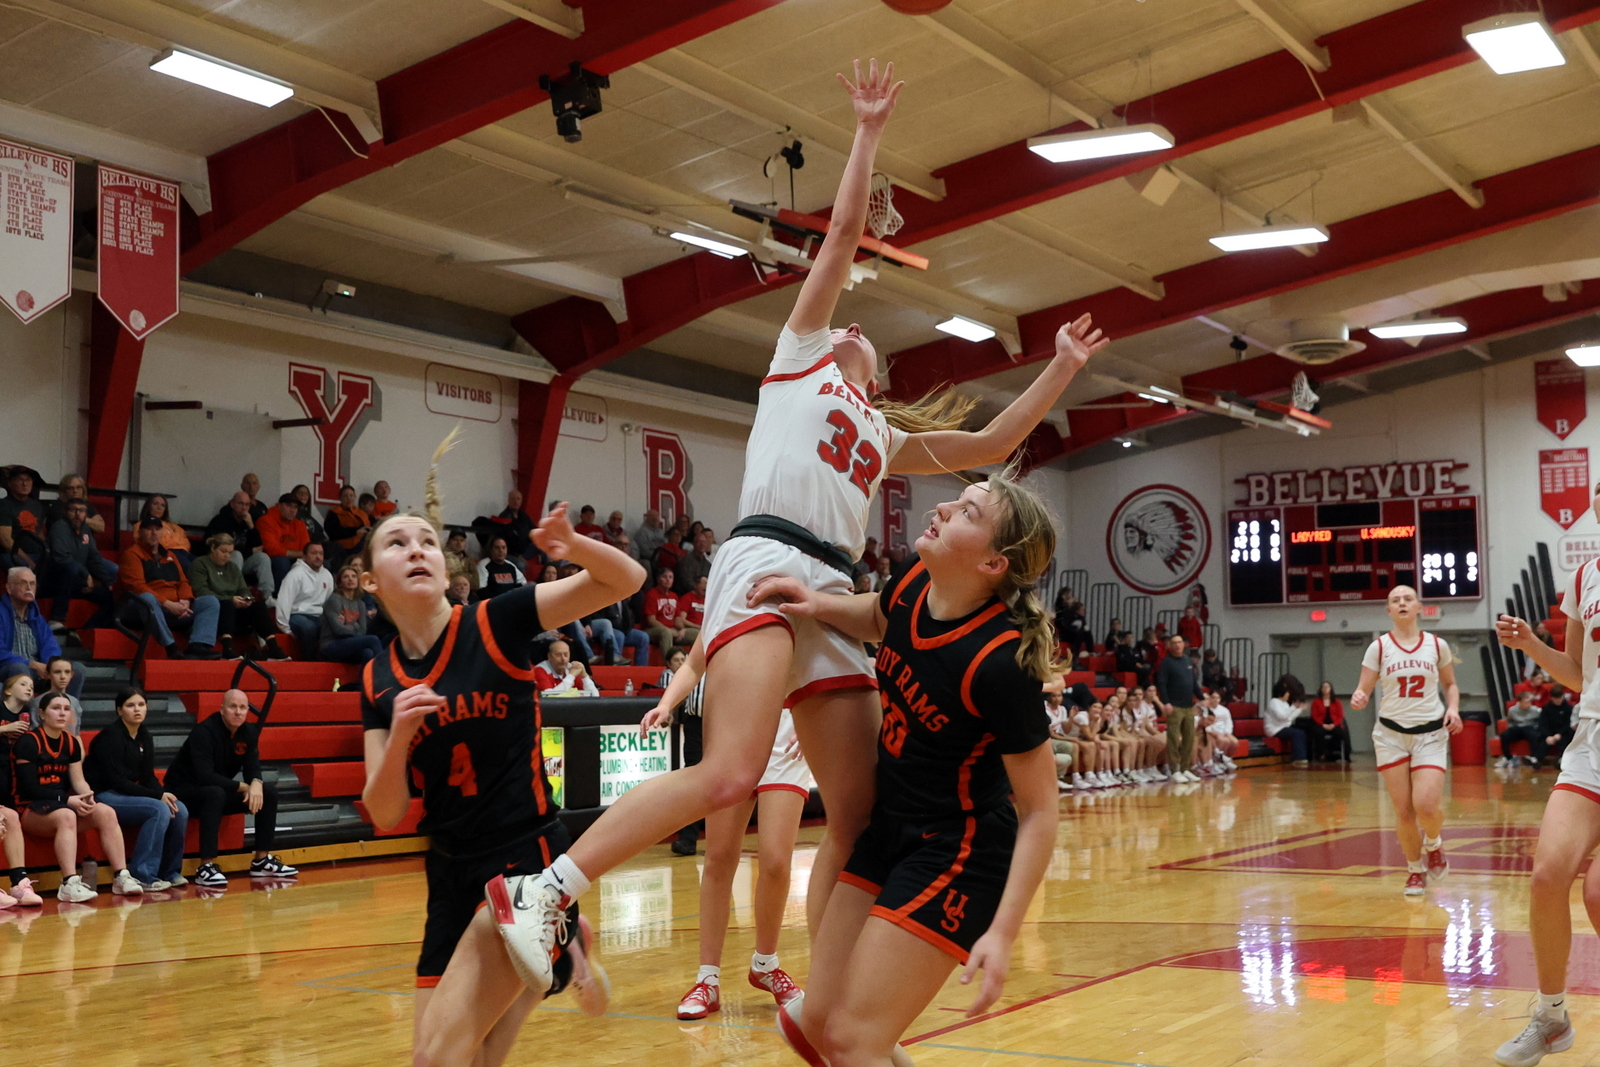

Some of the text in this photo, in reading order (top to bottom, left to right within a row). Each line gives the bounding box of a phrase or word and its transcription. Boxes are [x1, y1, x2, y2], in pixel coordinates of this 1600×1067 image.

[52, 159, 68, 179] HS
[24, 177, 43, 188] PLACE
[26, 185, 46, 196] PLACE
[101, 169, 175, 205] BELLEVUE HS
[23, 207, 43, 218] PLACE
[23, 214, 43, 225] PLACE
[23, 222, 42, 233] PLACE
[25, 230, 44, 241] PLACE
[136, 246, 154, 256] PLACE
[436, 381, 492, 404] VISITORS
[288, 362, 373, 505] Y
[1555, 419, 1570, 435] B
[817, 409, 882, 501] 32
[642, 428, 688, 531] R
[1246, 460, 1456, 506] BELLEVUE
[1559, 508, 1573, 524] B
[1566, 541, 1600, 551] BELL
[1397, 675, 1425, 698] 12
[895, 664, 950, 732] RAMS
[437, 691, 509, 727] RAMS
[600, 731, 668, 753] BECKLEY
[447, 742, 478, 797] 4
[640, 756, 667, 772] HEATING
[601, 782, 613, 798] AIR
